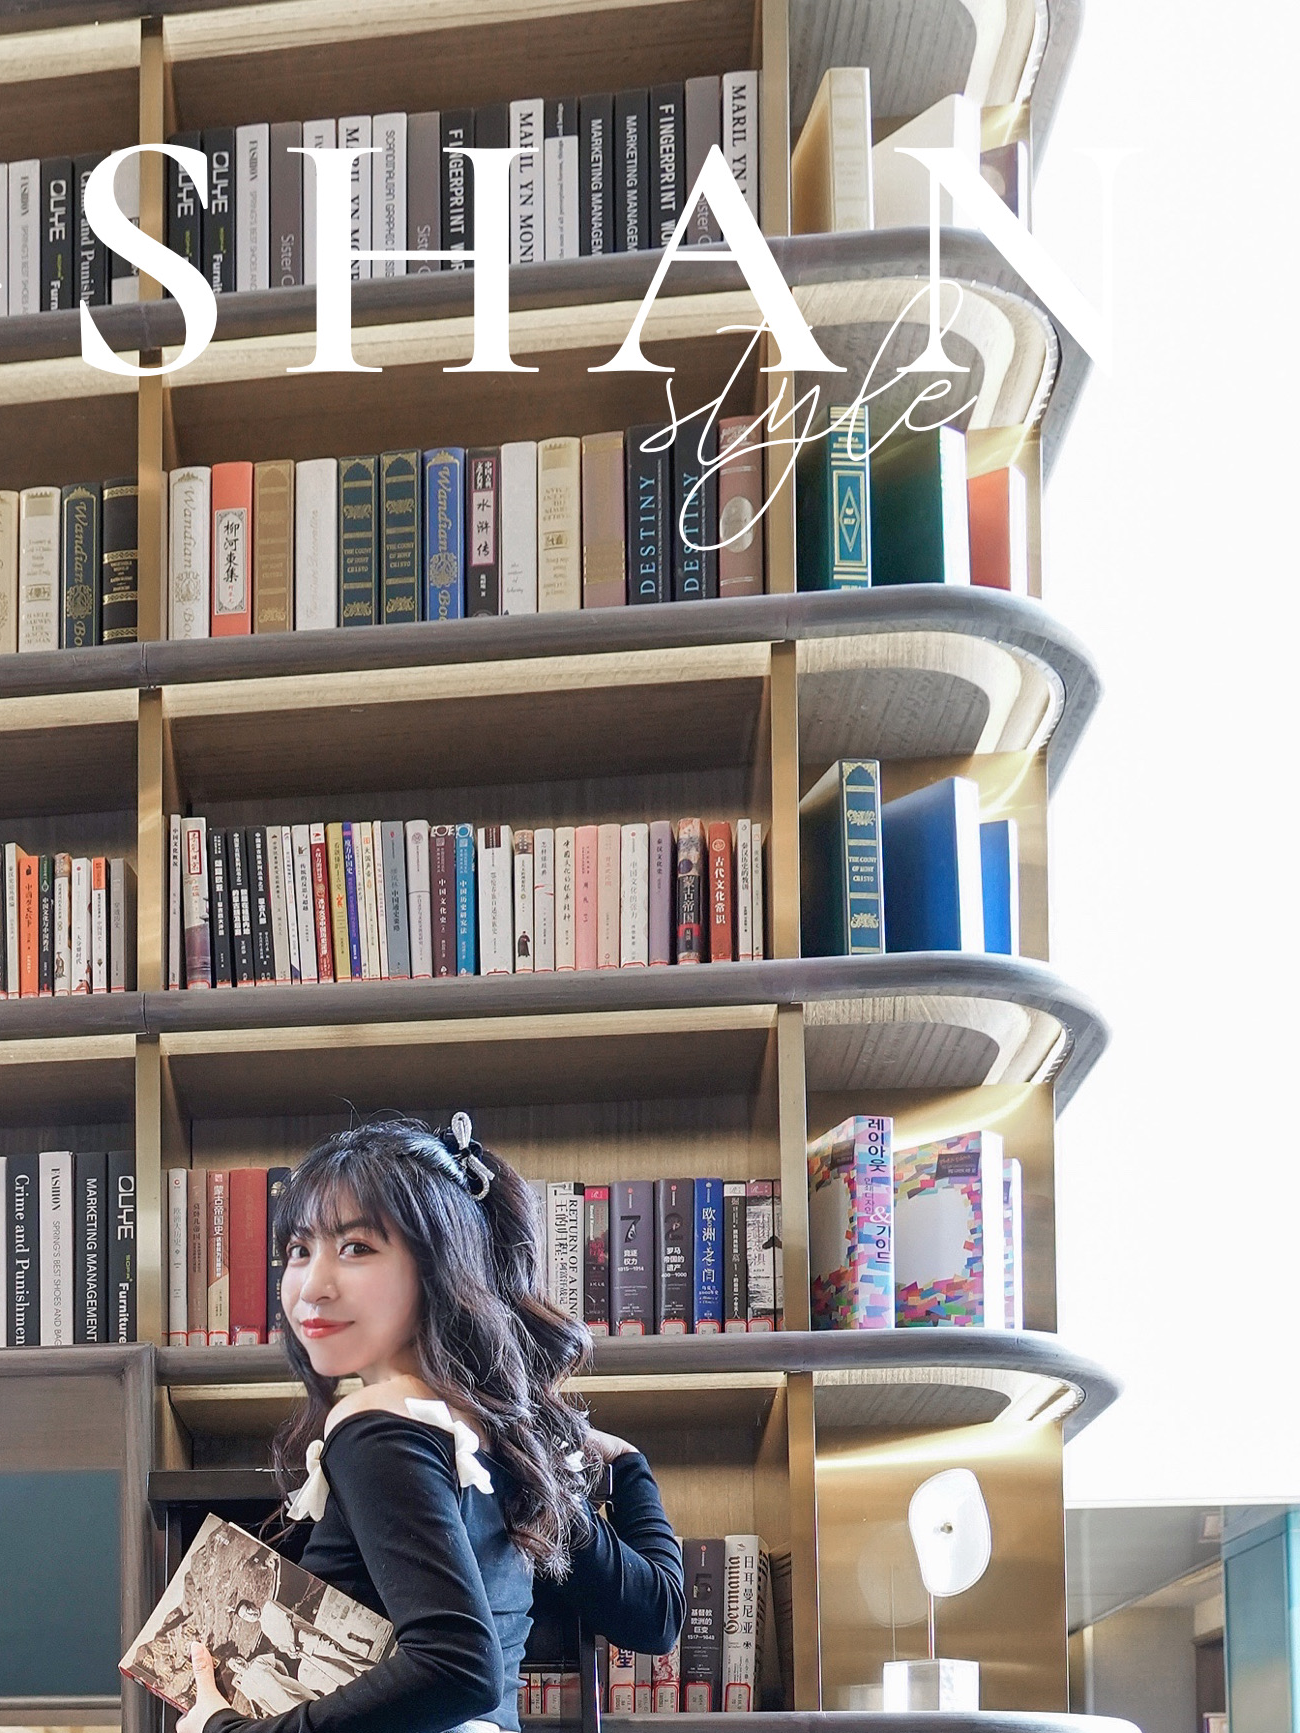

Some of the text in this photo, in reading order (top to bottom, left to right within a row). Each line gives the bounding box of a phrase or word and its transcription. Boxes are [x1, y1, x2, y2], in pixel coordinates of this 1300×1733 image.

[591, 119, 604, 195] MARKETING
[625, 115, 638, 189] MARKETING
[659, 103, 675, 211] FINGERPRINT
[732, 84, 746, 181] MARIL YN
[281, 234, 294, 271] Sister
[223, 521, 240, 584] 柳河東集
[476, 498, 491, 557] 水浒传
[639, 476, 656, 594] DESTINY
[683, 472, 699, 592] DESTINY
[438, 878, 447, 924] 中国文化史
[459, 879, 468, 934] 中国历史研究法
[682, 876, 694, 924] 蒙古帝国
[714, 856, 726, 924] 古代文化常识
[868, 1118, 887, 1173] 레이아웃
[15, 1174, 30, 1221] Crime
[51, 1168, 61, 1211] FASHION
[15, 1224, 30, 1254] and
[86, 1179, 98, 1341] MARKETING MANAGEMENT
[568, 1199, 578, 1273] RETURN OF
[664, 1255, 685, 1263] 帝国的
[666, 1247, 681, 1255] 罗马
[702, 1206, 716, 1283] 欧洲之门
[666, 1263, 682, 1272] 遗产
[118, 1283, 130, 1344] Furniture
[690, 1617, 713, 1626] 欧洲的
[691, 1608, 713, 1617] 基督教
[742, 1555, 754, 1634] 日耳曼尼亚
